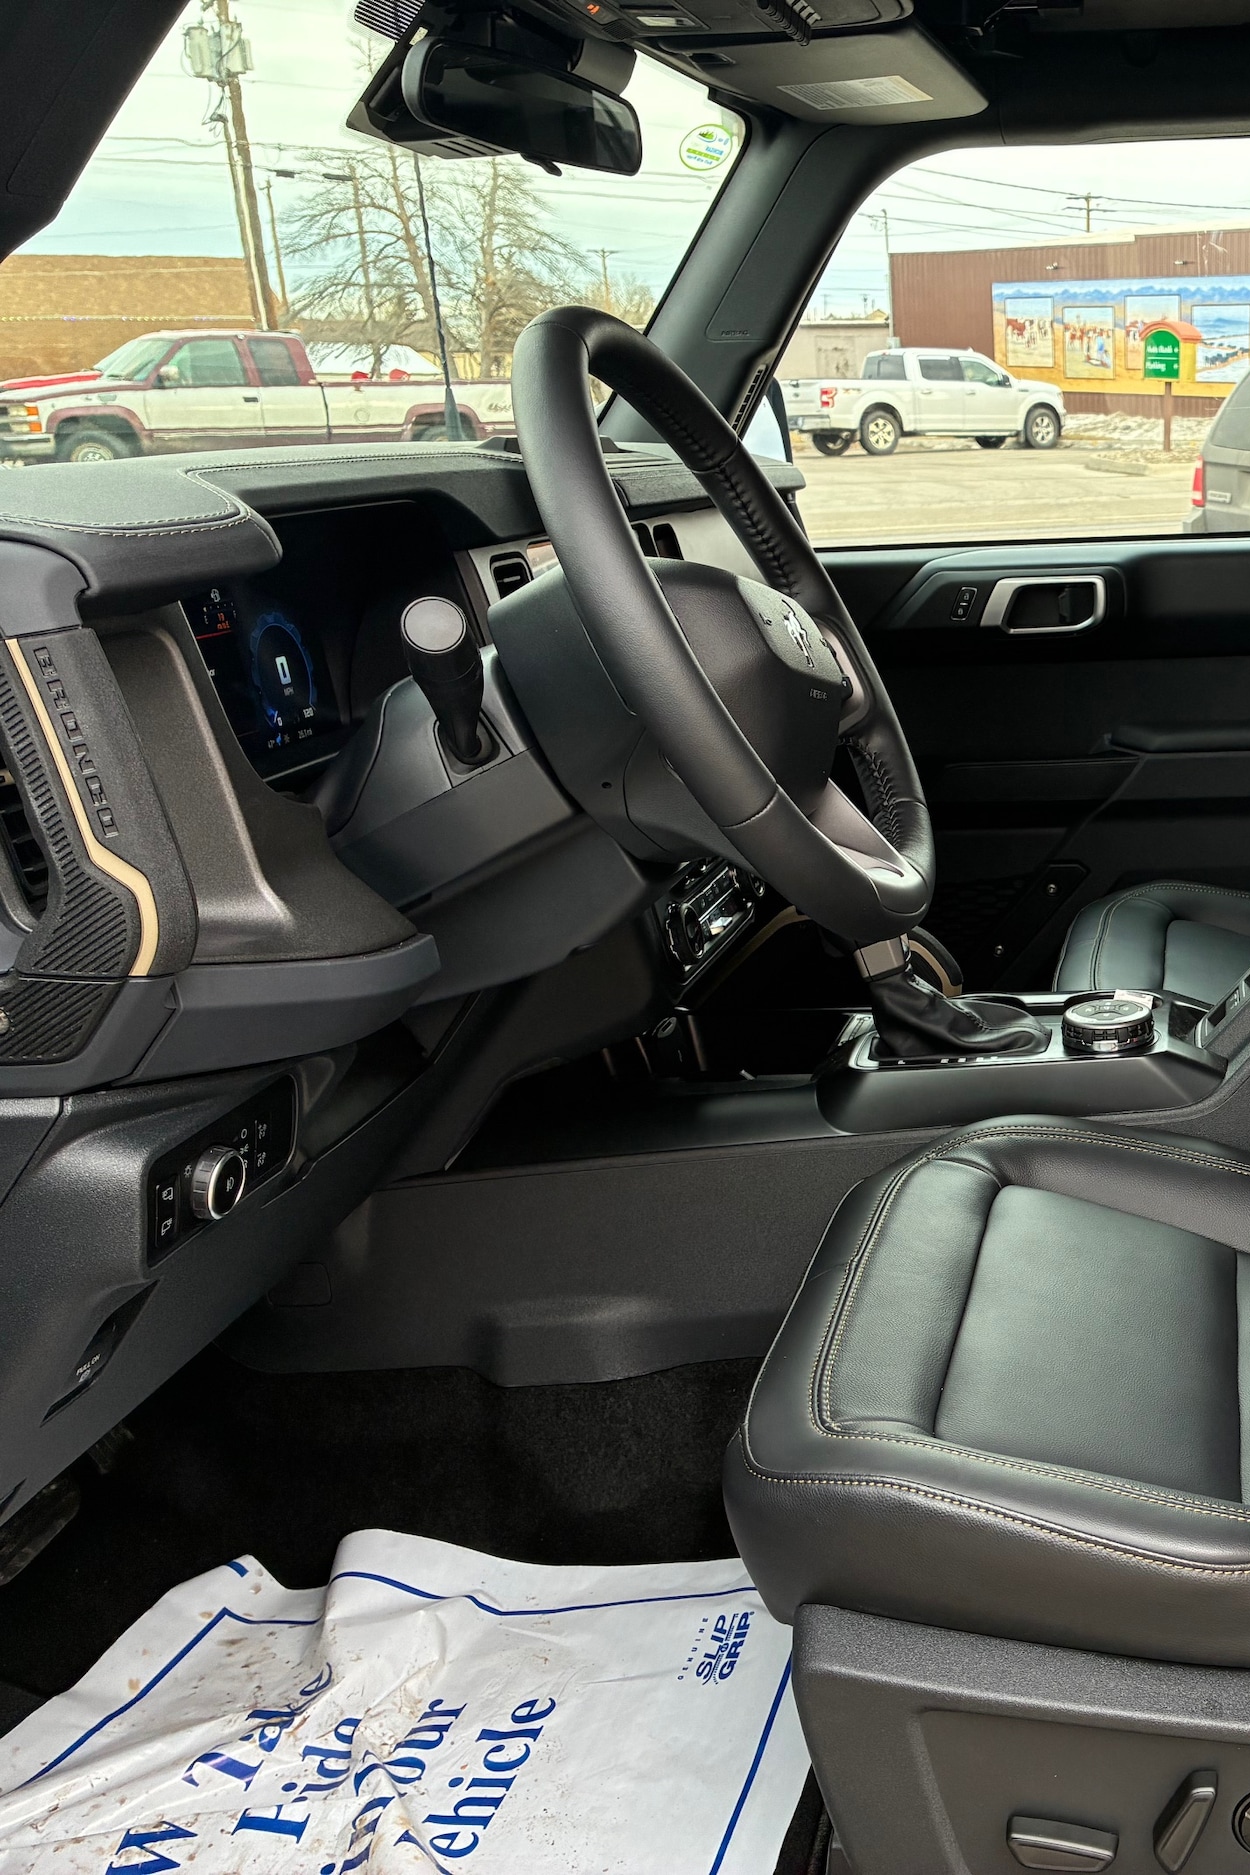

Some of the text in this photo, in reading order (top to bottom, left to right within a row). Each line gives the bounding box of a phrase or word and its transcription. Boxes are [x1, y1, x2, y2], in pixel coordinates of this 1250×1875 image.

[275, 655, 291, 685] 0
[33, 646, 120, 839] BRONCO
[303, 707, 314, 718] 120
[677, 1617, 709, 1681] GENUINE
[695, 1614, 727, 1681] SLIP
